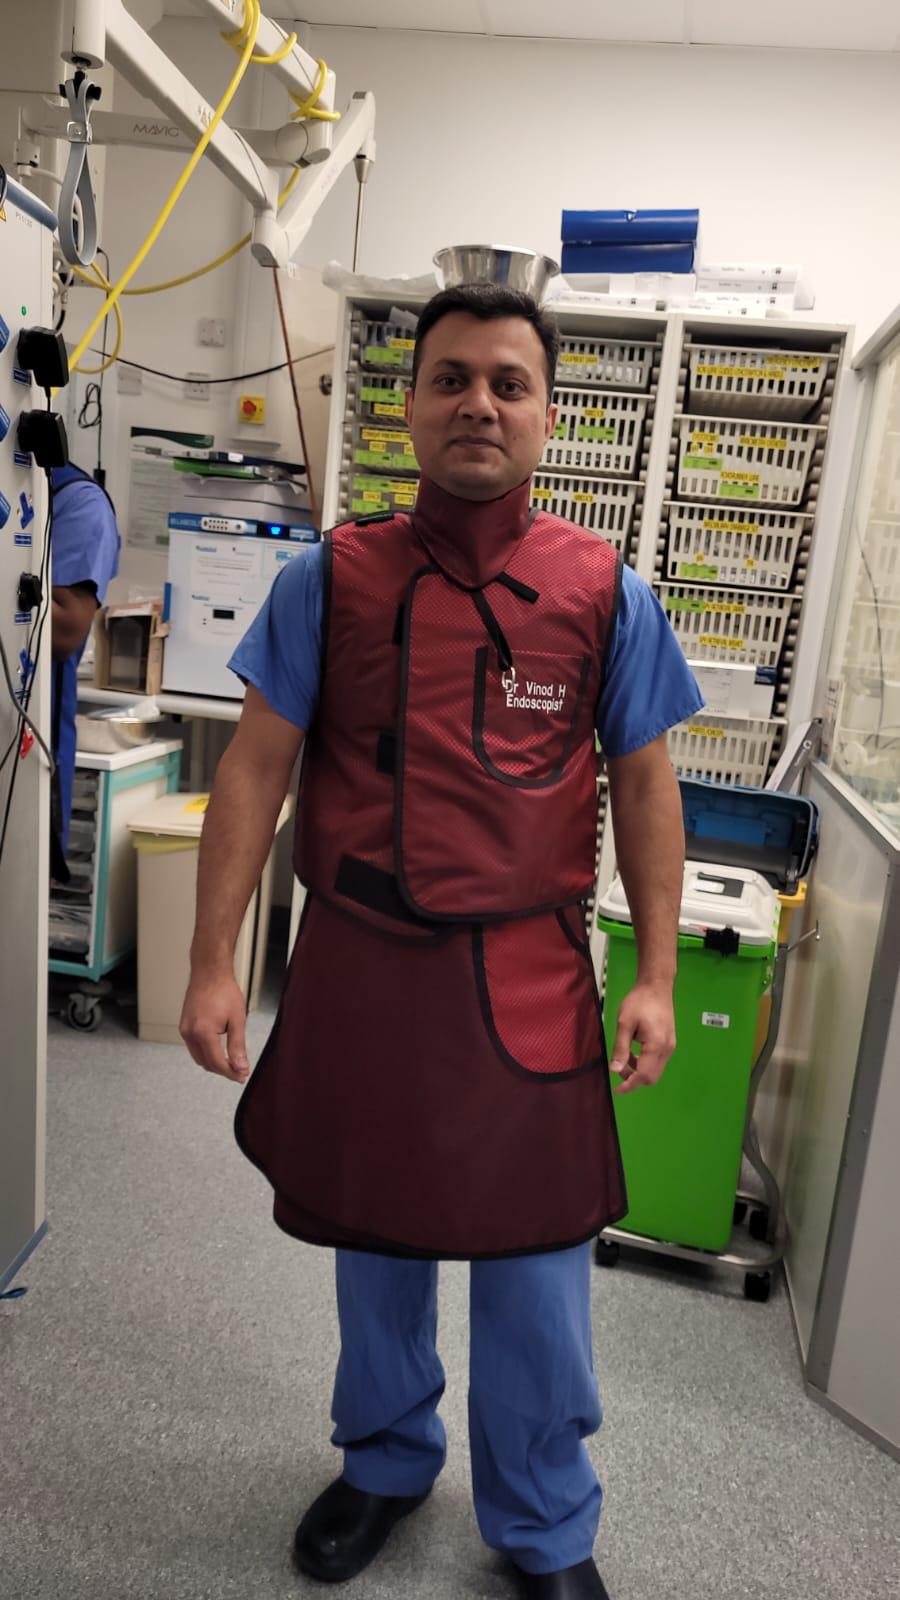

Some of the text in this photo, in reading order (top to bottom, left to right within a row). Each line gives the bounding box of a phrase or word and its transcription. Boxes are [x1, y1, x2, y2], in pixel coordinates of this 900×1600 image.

[133, 123, 180, 137] MAVIG
[505, 679, 566, 698] Dr Vinod H
[506, 694, 564, 714] Endoscopist
